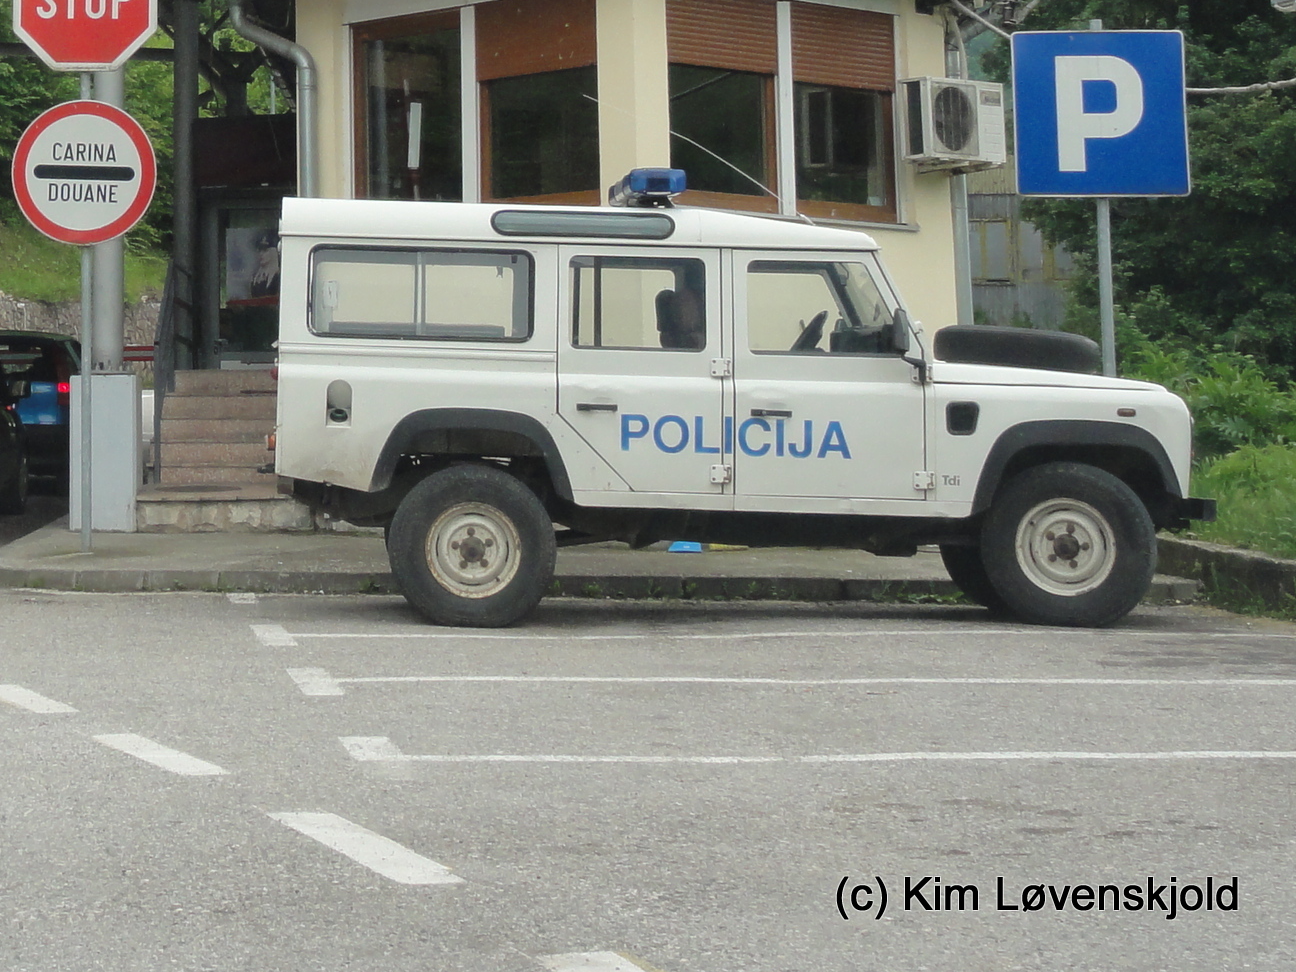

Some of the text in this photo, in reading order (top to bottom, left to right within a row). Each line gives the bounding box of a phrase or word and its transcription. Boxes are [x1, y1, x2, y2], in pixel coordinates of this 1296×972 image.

[1055, 55, 1144, 172] P
[52, 142, 117, 162] CARINA
[48, 183, 118, 203] DOUANE
[620, 414, 852, 459] POLICIJA
[941, 474, 961, 487] Tdi
